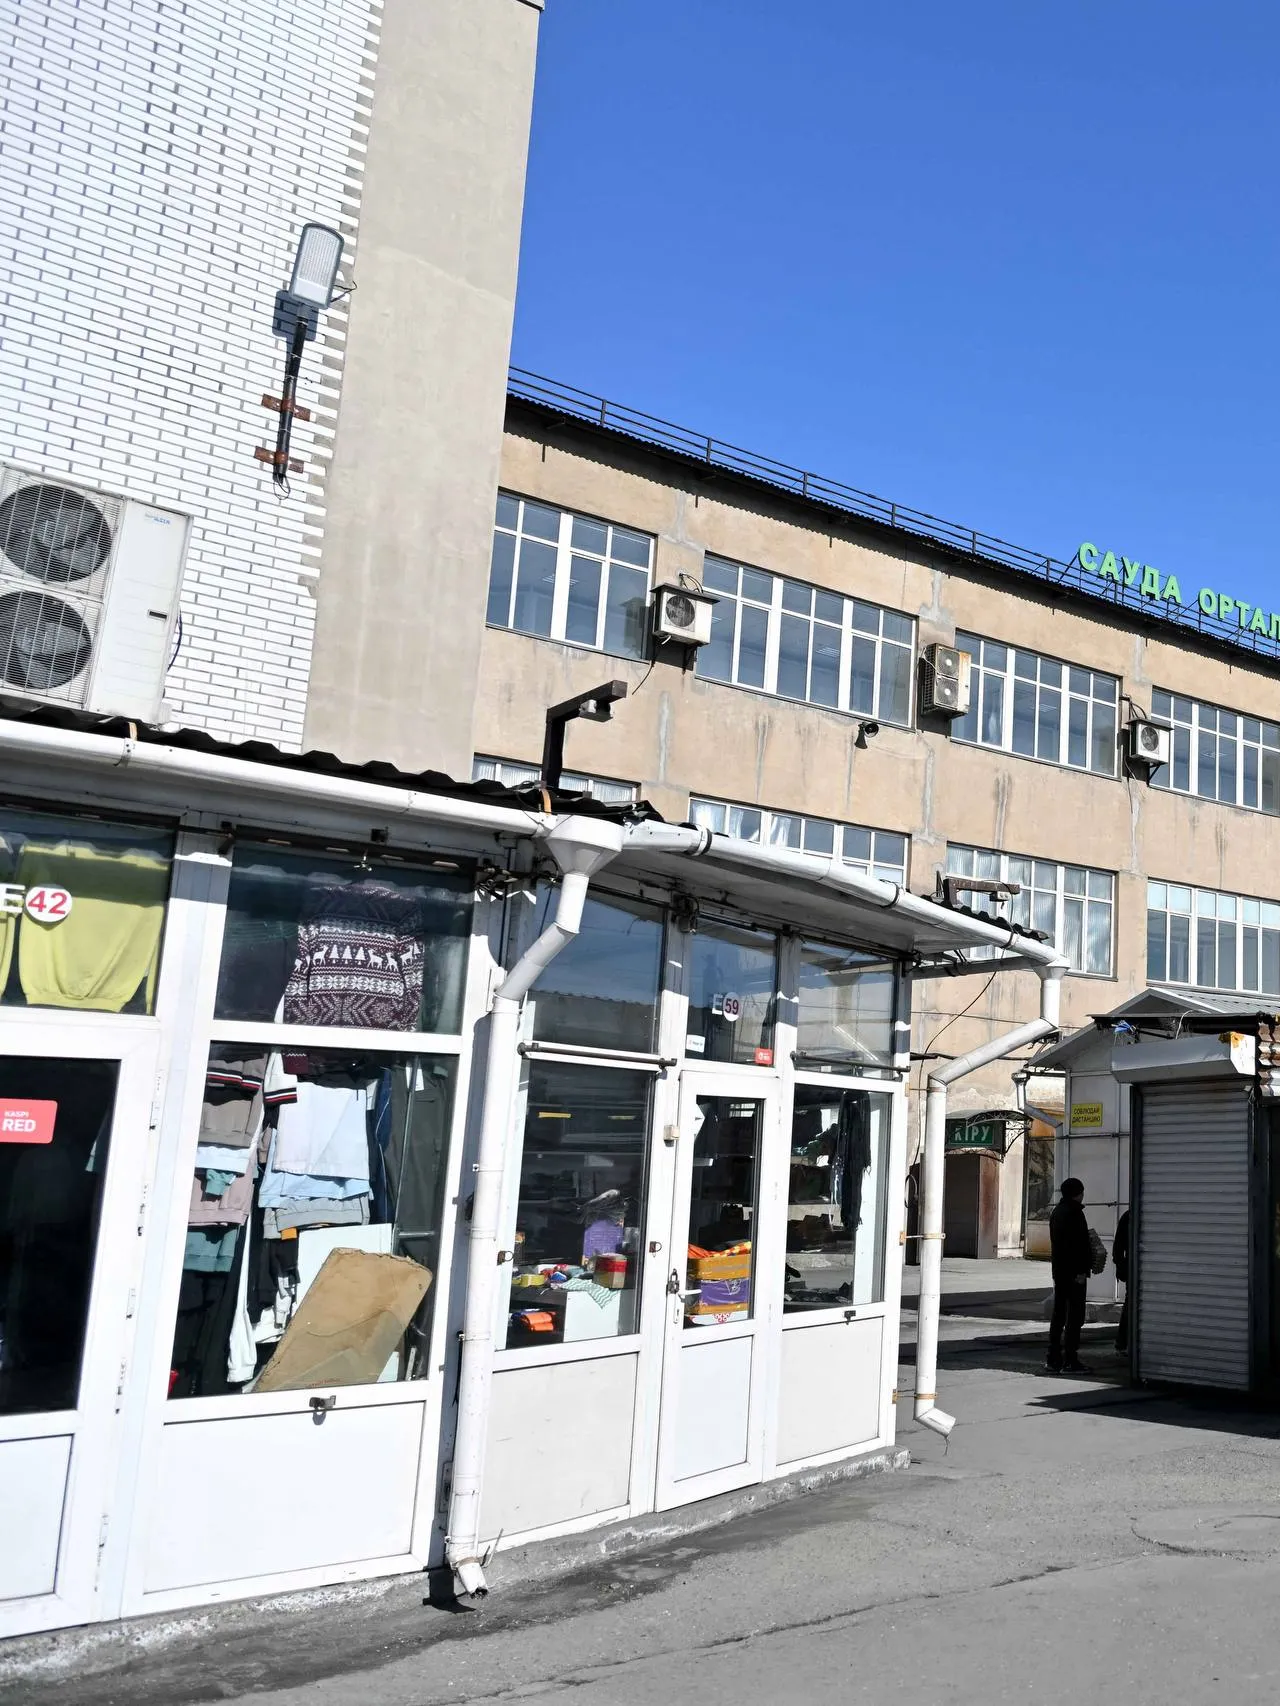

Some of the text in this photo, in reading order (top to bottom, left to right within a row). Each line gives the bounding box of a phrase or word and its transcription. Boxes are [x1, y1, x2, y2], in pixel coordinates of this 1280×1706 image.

[1078, 541, 1181, 603] САУДА
[28, 890, 67, 915] 42
[725, 998, 740, 1016] 59
[4, 1110, 30, 1118] KASPI
[2, 1118, 37, 1133] RED
